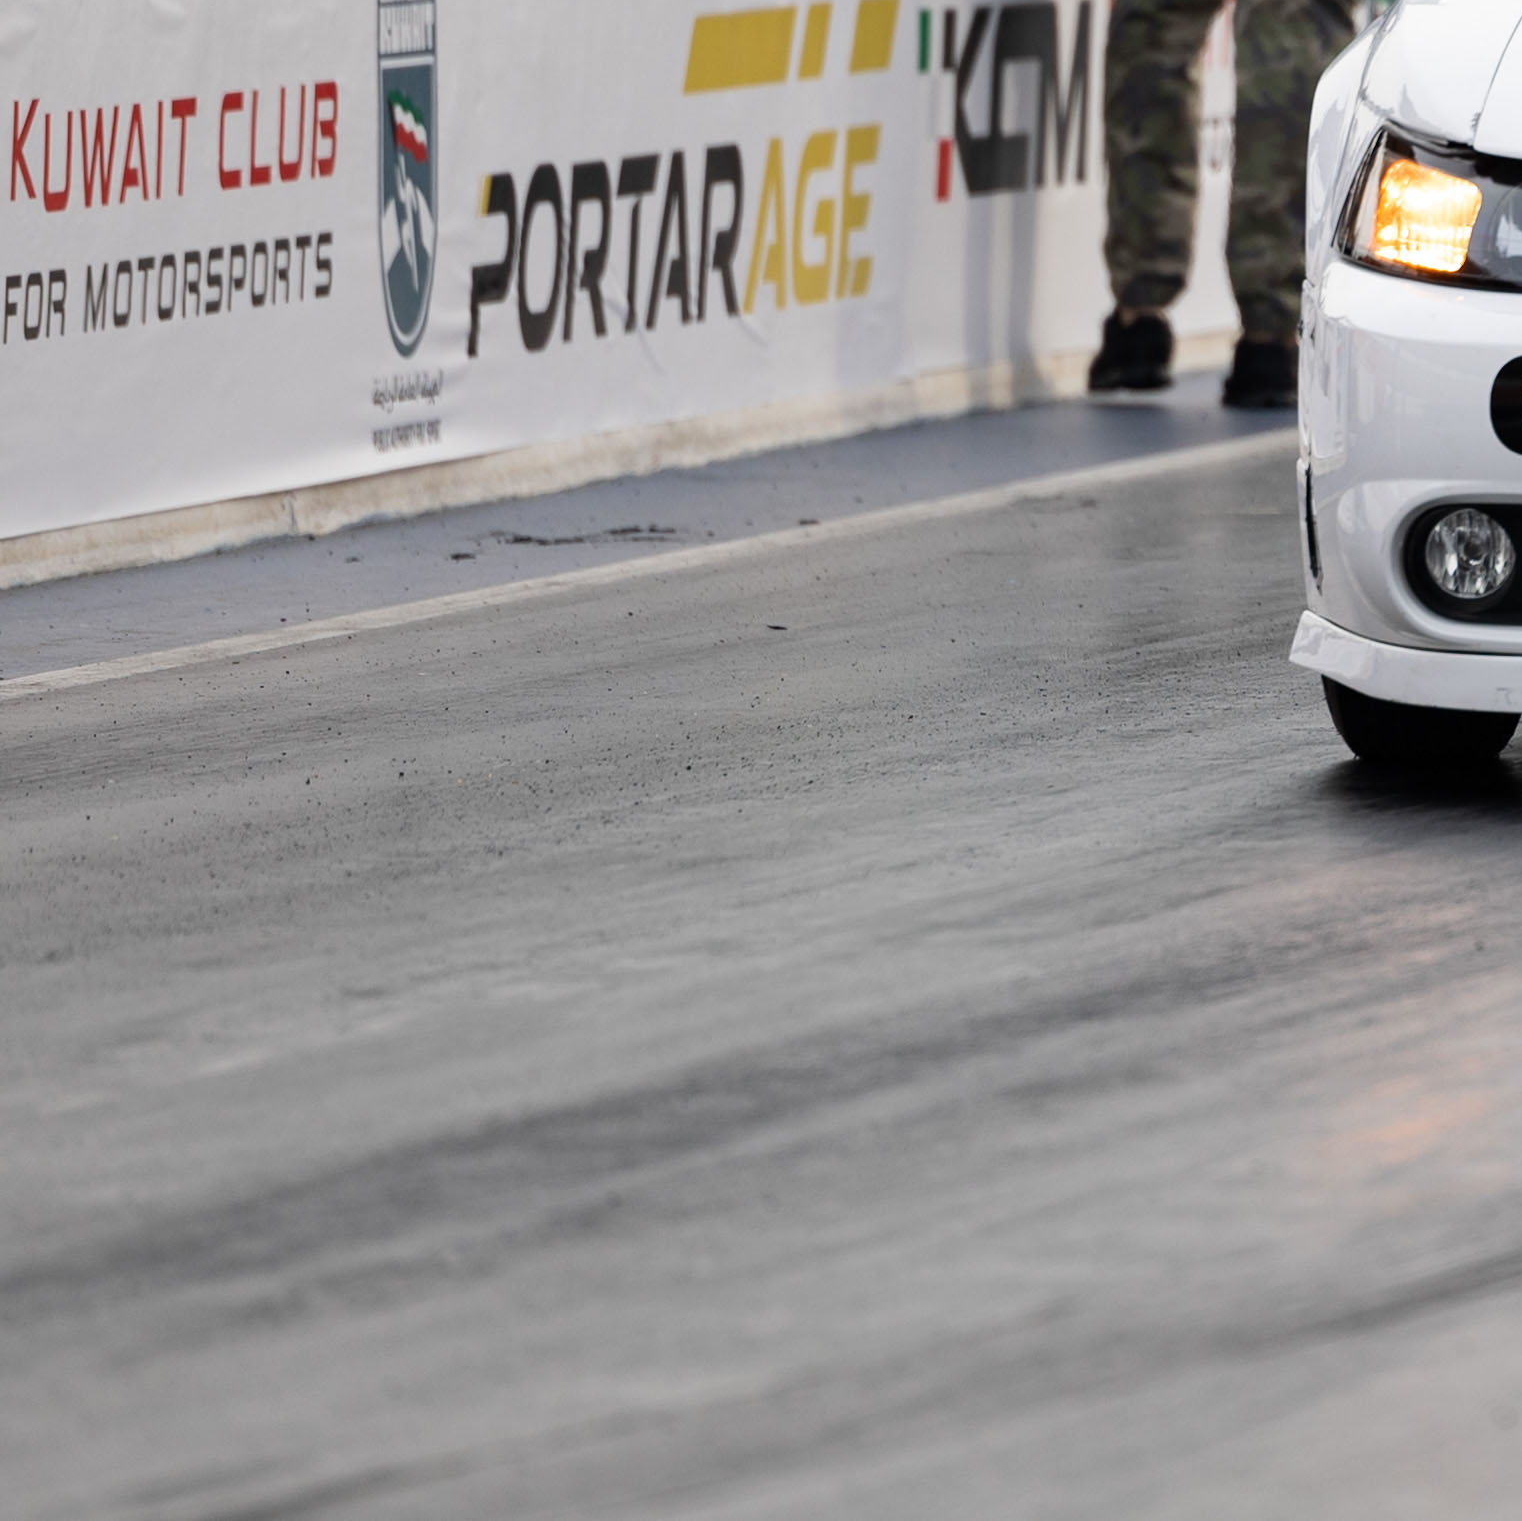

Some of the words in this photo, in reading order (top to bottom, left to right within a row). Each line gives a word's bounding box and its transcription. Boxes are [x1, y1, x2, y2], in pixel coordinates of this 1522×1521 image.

[10, 96, 197, 213] KUWAIT
[219, 81, 338, 190] CLUB
[3, 269, 67, 345] FOR
[83, 232, 333, 333] MOTORSPORTS
[467, 123, 882, 358] PORTARAGE
